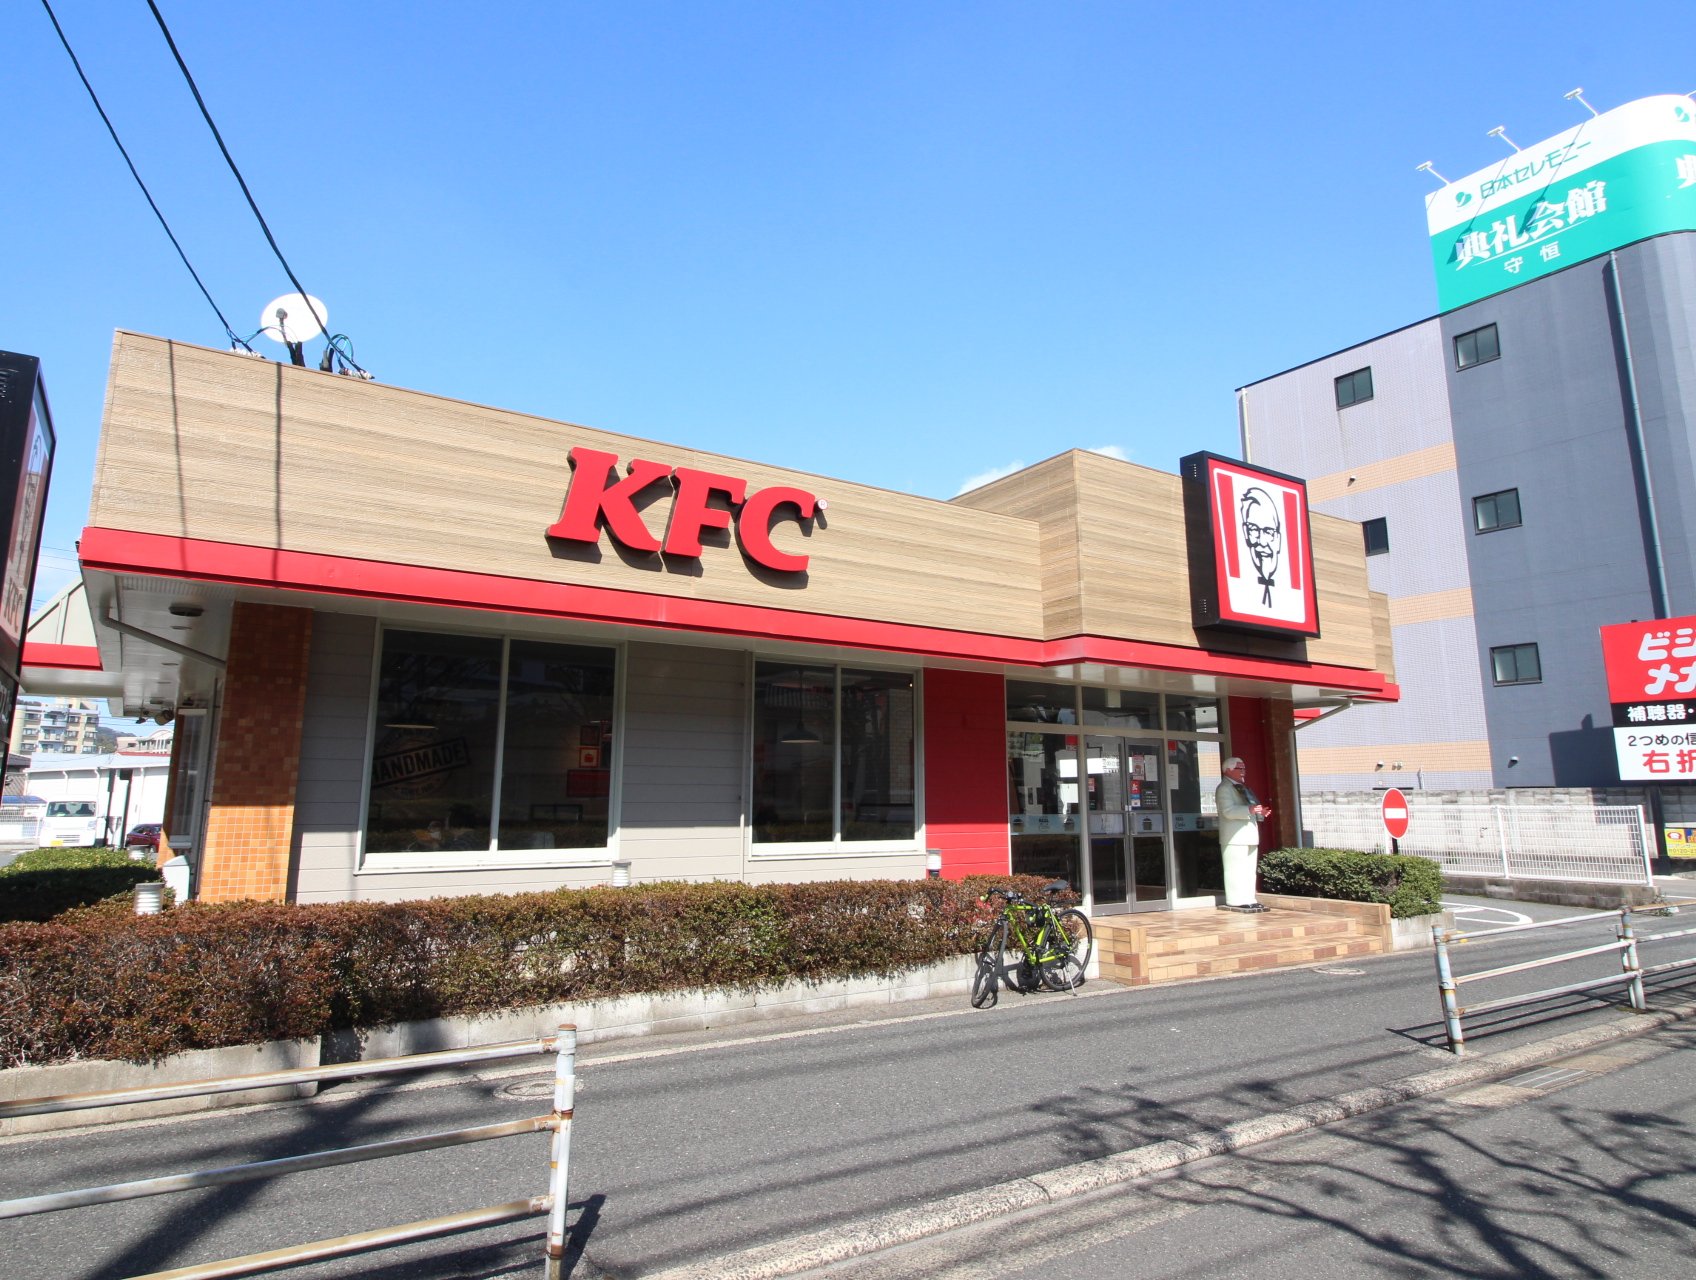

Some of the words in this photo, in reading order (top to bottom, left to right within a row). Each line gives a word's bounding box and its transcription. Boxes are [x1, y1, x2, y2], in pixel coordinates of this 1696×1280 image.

[1480, 141, 1592, 199] 日本セレモニー
[1455, 179, 1607, 272] 典礼会館
[545, 446, 816, 572] KFC
